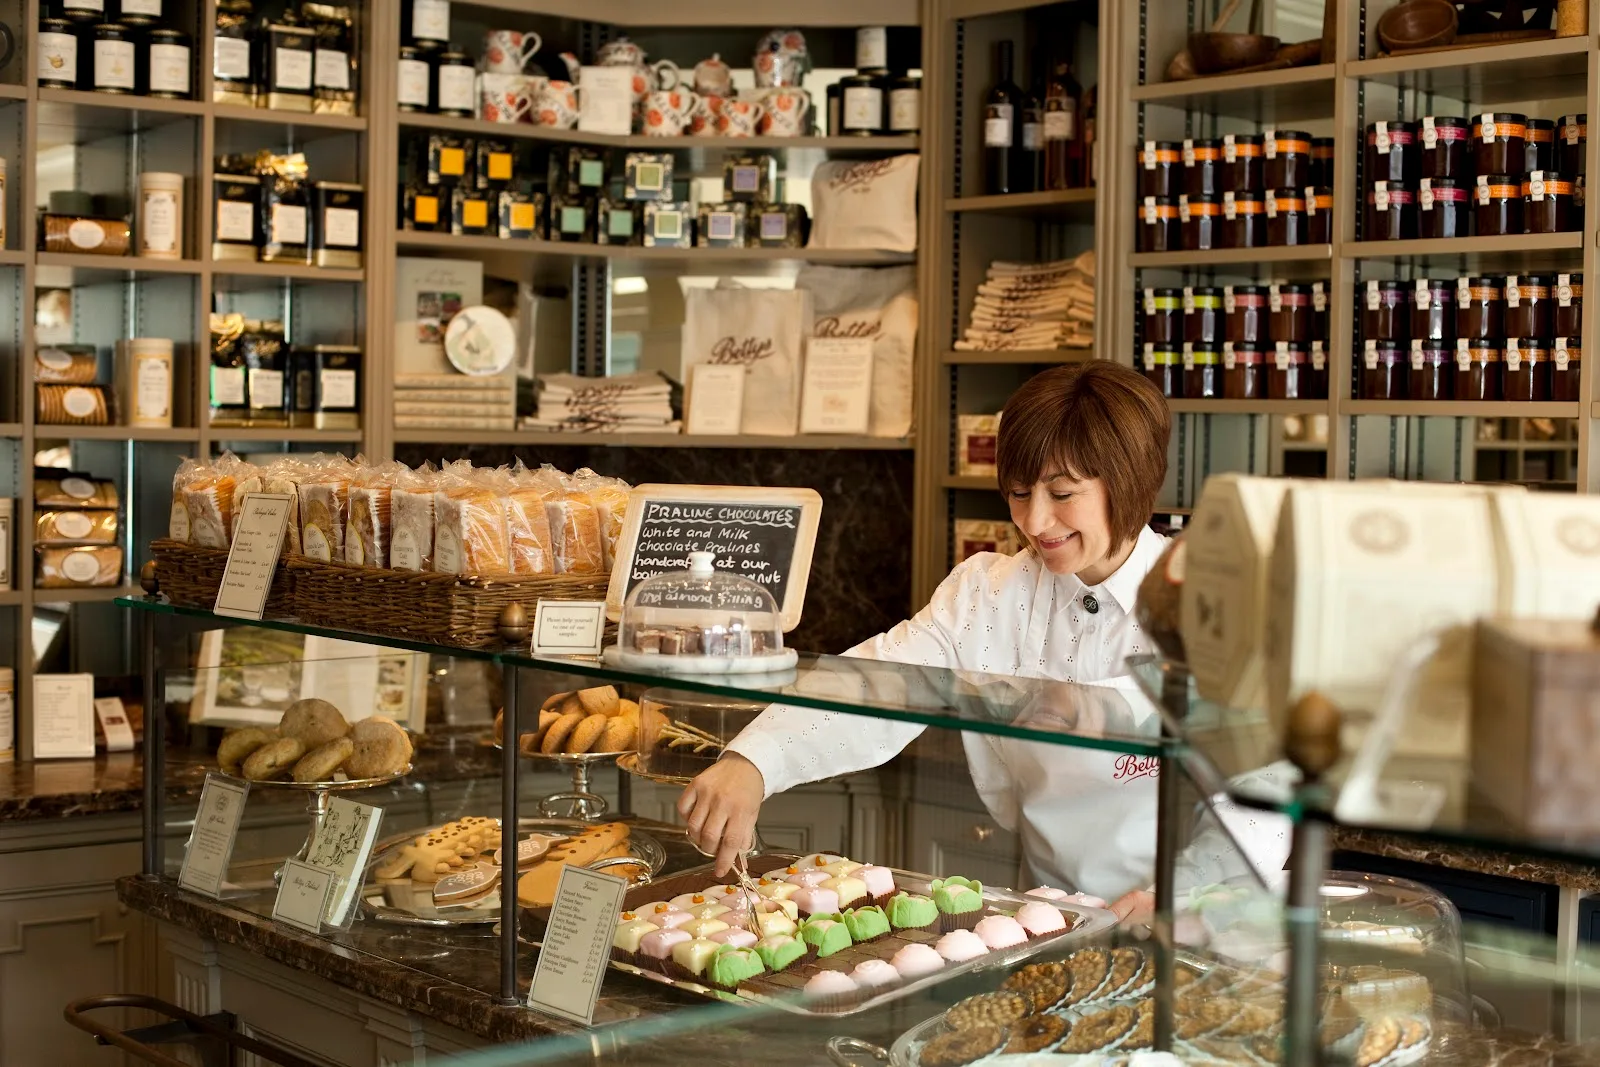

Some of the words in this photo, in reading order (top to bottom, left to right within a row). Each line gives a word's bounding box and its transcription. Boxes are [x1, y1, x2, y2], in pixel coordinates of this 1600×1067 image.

[707, 336, 776, 365] Bettys
[647, 504, 713, 519] PRALINE
[718, 507, 794, 522] CHOCOLATES
[686, 527, 711, 538] and
[718, 527, 750, 540] Milk
[638, 540, 699, 552] chocolate
[716, 555, 736, 569] at
[741, 559, 770, 570] our
[665, 591, 713, 605] almond
[718, 591, 763, 609] filling
